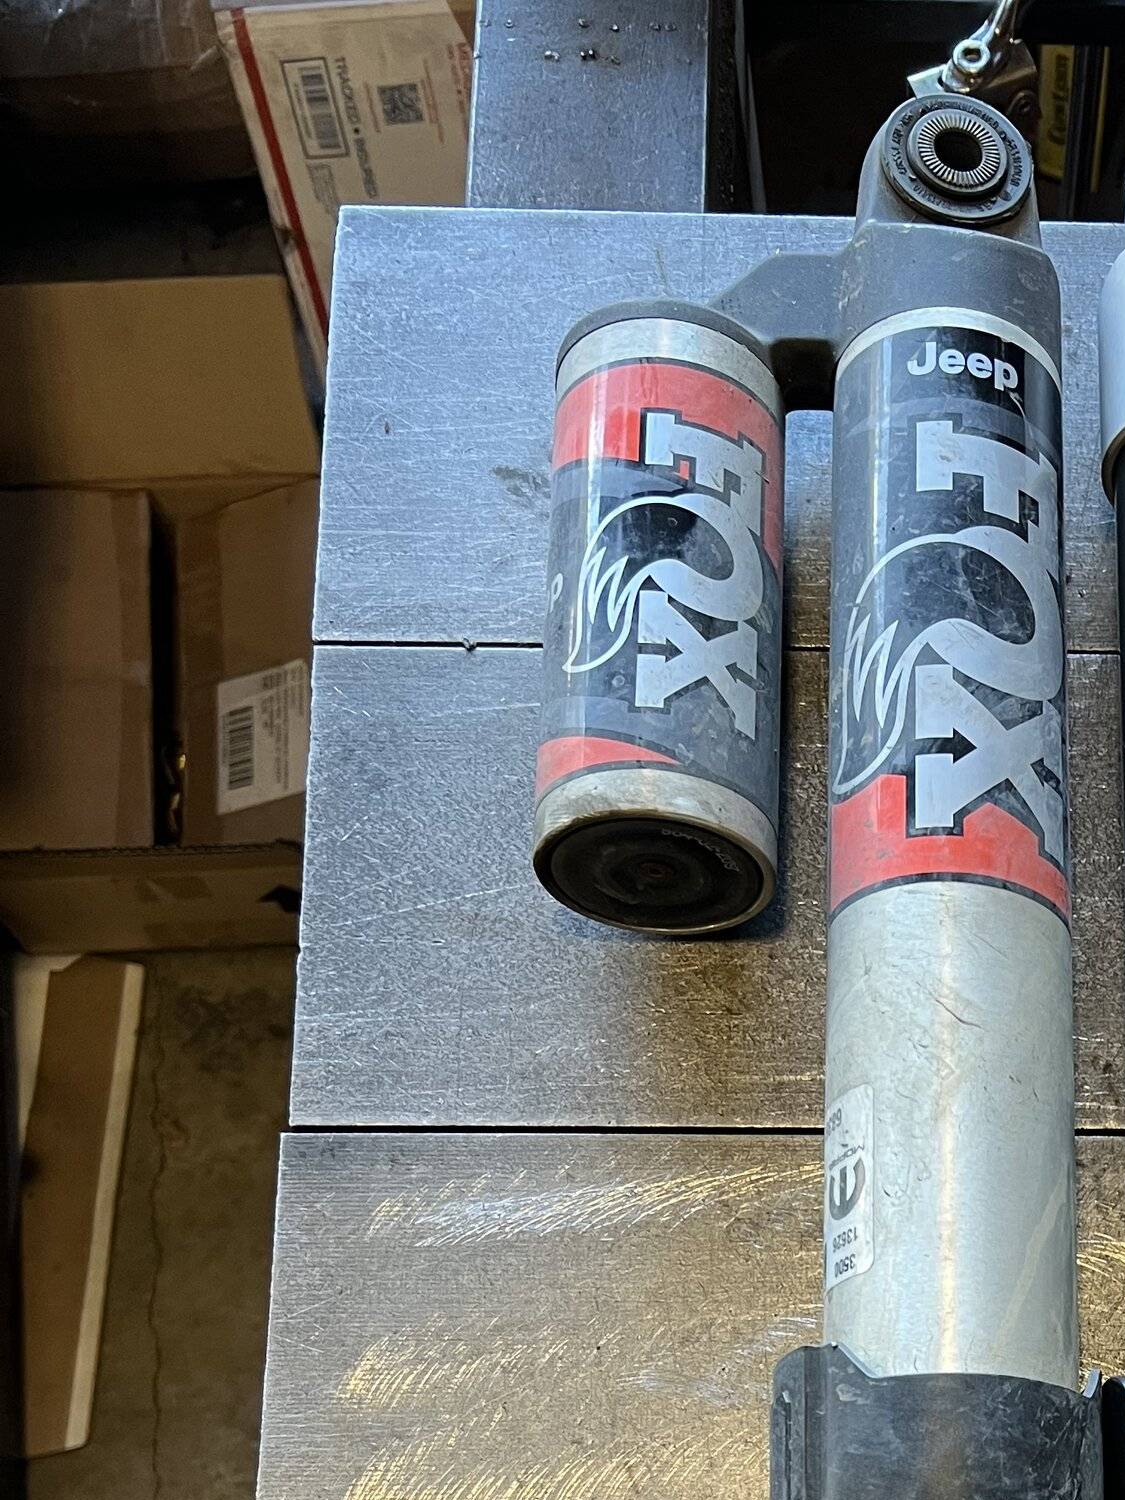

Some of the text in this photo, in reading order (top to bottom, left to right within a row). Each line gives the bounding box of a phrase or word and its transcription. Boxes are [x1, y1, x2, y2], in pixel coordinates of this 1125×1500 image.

[906, 340, 1020, 392] Jeep
[634, 412, 763, 740] FOX
[913, 419, 1064, 868] FOX
